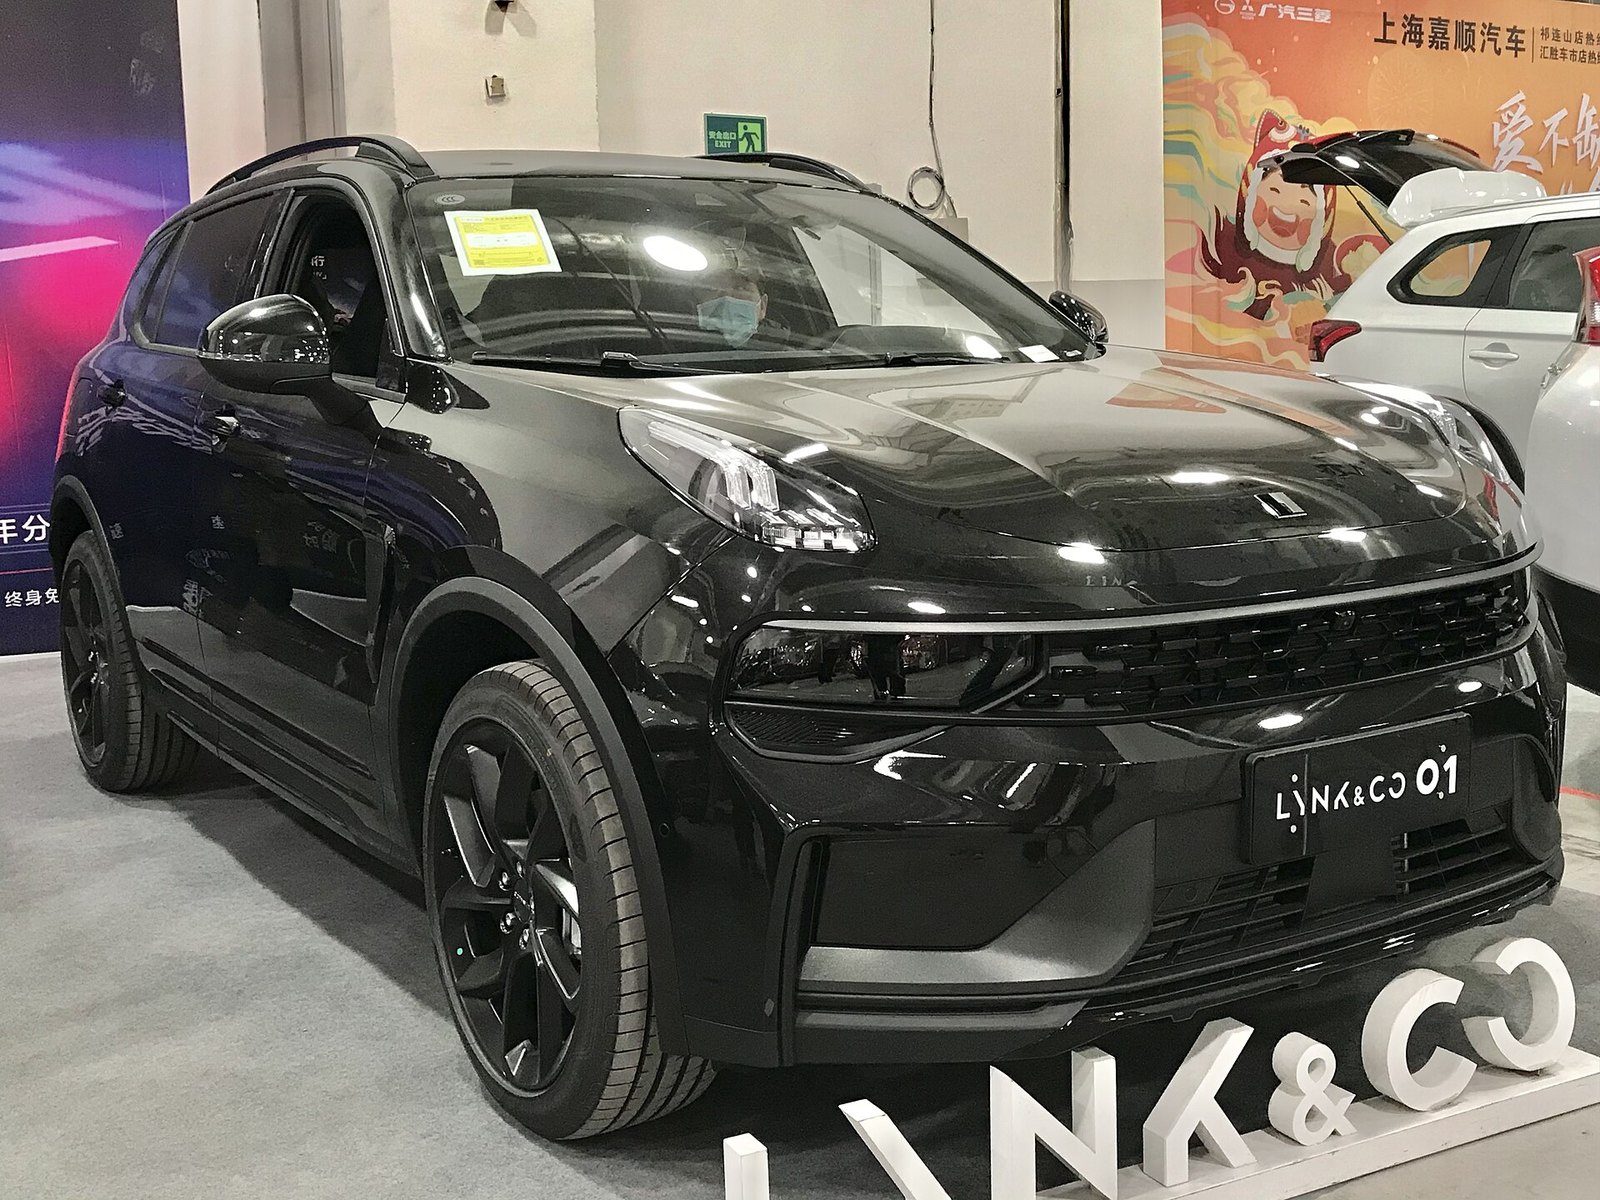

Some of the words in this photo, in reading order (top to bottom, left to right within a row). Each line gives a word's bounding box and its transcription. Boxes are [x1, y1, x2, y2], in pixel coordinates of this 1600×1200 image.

[1258, 3, 1331, 24] 广汽三菱
[1374, 11, 1526, 58] 上海嘉顺汽车
[708, 130, 737, 140] 安全出口
[714, 140, 732, 149] EXIT
[4, 587, 60, 608] 终身免
[1416, 755, 1458, 796] 01
